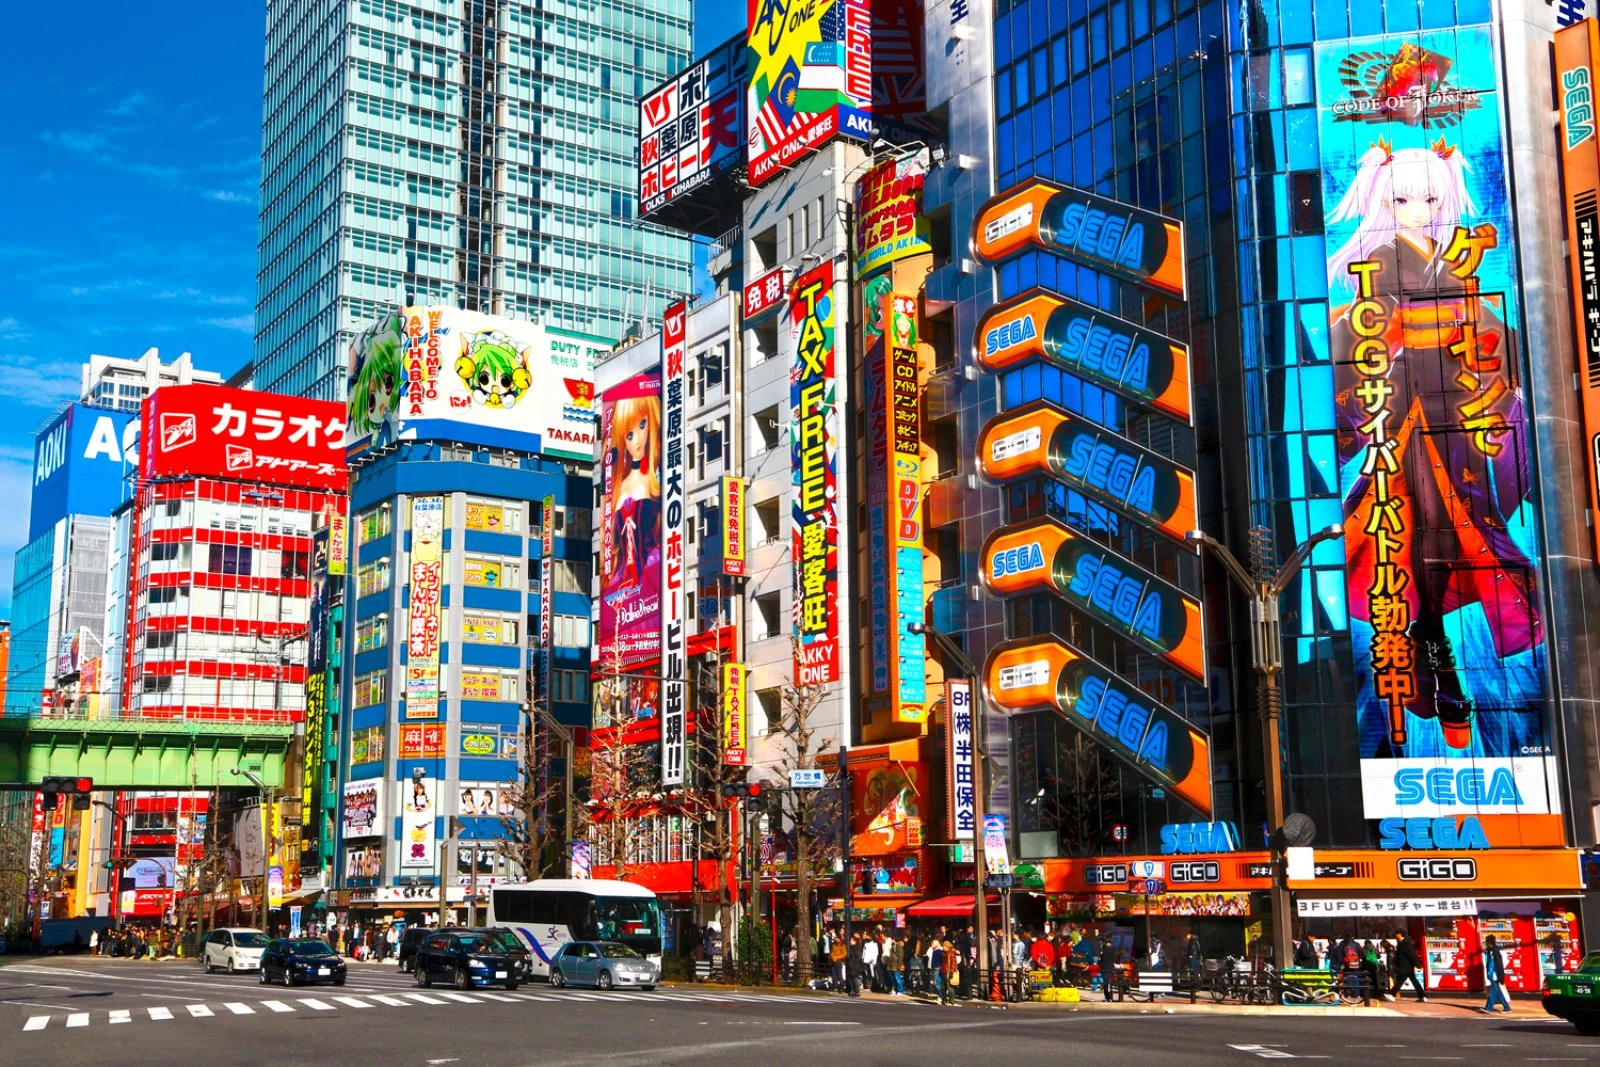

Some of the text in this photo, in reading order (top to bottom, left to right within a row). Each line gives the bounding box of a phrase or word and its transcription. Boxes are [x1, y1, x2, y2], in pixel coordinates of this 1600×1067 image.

[789, 0, 817, 33] ONE
[1332, 85, 1480, 117] CODE OF JOKER
[1562, 66, 1594, 151] SEGA
[641, 107, 699, 166] 秋葉原
[641, 152, 698, 199] ホビー
[1055, 202, 1145, 270] SEGA
[748, 273, 780, 313] 免税
[427, 310, 442, 400] WELCOME TO
[551, 340, 580, 355] DUTY
[801, 281, 826, 381] TAX
[986, 313, 1037, 357] SEGA
[1057, 317, 1150, 391] SEGA
[1444, 222, 1508, 457] ゲーセンで
[409, 315, 424, 416] AKIHABARA
[896, 365, 914, 377] CD
[894, 394, 917, 406] アニメ
[35, 421, 68, 486] AOKI
[801, 382, 826, 503] FREE
[1063, 433, 1156, 515] SEGA
[728, 481, 739, 555] 愛客旺免税店
[898, 479, 919, 542] DVD
[332, 518, 343, 562] まんが喫茶
[666, 349, 684, 778] 秋葉原最大のホビービル出現!!
[992, 541, 1044, 580] SEGA
[410, 561, 427, 657] まんが喫茶
[427, 561, 441, 657] インターネット
[1069, 553, 1162, 641] SEGA
[802, 663, 830, 683] ONE
[405, 729, 440, 745] 麻雀
[1073, 675, 1168, 771] SEGA
[1393, 767, 1524, 806] SEGA
[1160, 821, 1242, 853] SEGA
[1379, 816, 1490, 849] SEGA
[1084, 863, 1129, 884] GiGO
[1170, 861, 1220, 883] GiGO
[1397, 857, 1478, 881] GiGO
